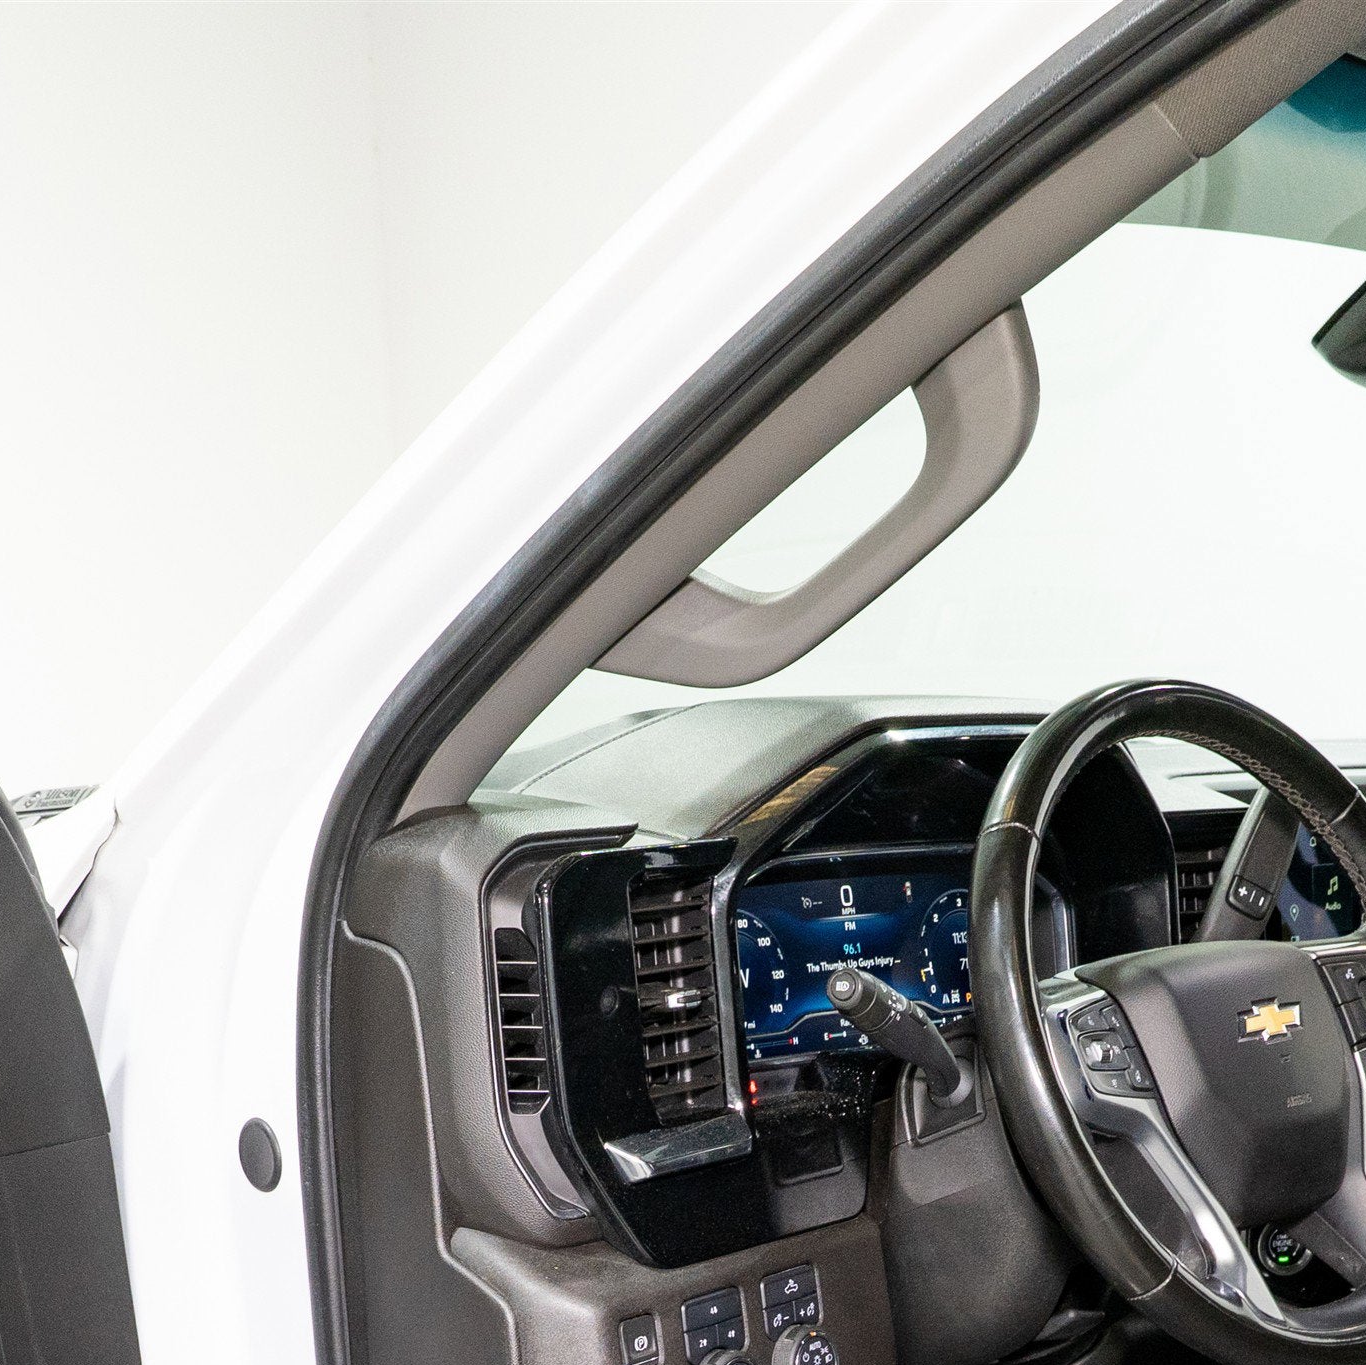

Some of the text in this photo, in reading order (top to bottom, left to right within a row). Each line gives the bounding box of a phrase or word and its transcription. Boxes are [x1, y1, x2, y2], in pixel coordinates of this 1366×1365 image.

[840, 884, 854, 907] 0
[956, 897, 963, 907] 3
[1325, 902, 1342, 911] Audio
[933, 913, 939, 923] 2
[737, 919, 749, 929] 80
[844, 921, 857, 931] FM
[756, 937, 771, 947] 100
[843, 942, 862, 955] 96.1
[924, 947, 929, 957] 1
[806, 962, 821, 973] The
[820, 960, 848, 972] Thumbs
[847, 958, 858, 969] Up
[858, 957, 875, 970] Guys
[875, 956, 895, 968] Injury
[771, 969, 785, 980] 120
[930, 984, 937, 994] 0
[769, 1003, 783, 1013] 140
[824, 1032, 830, 1041] E
